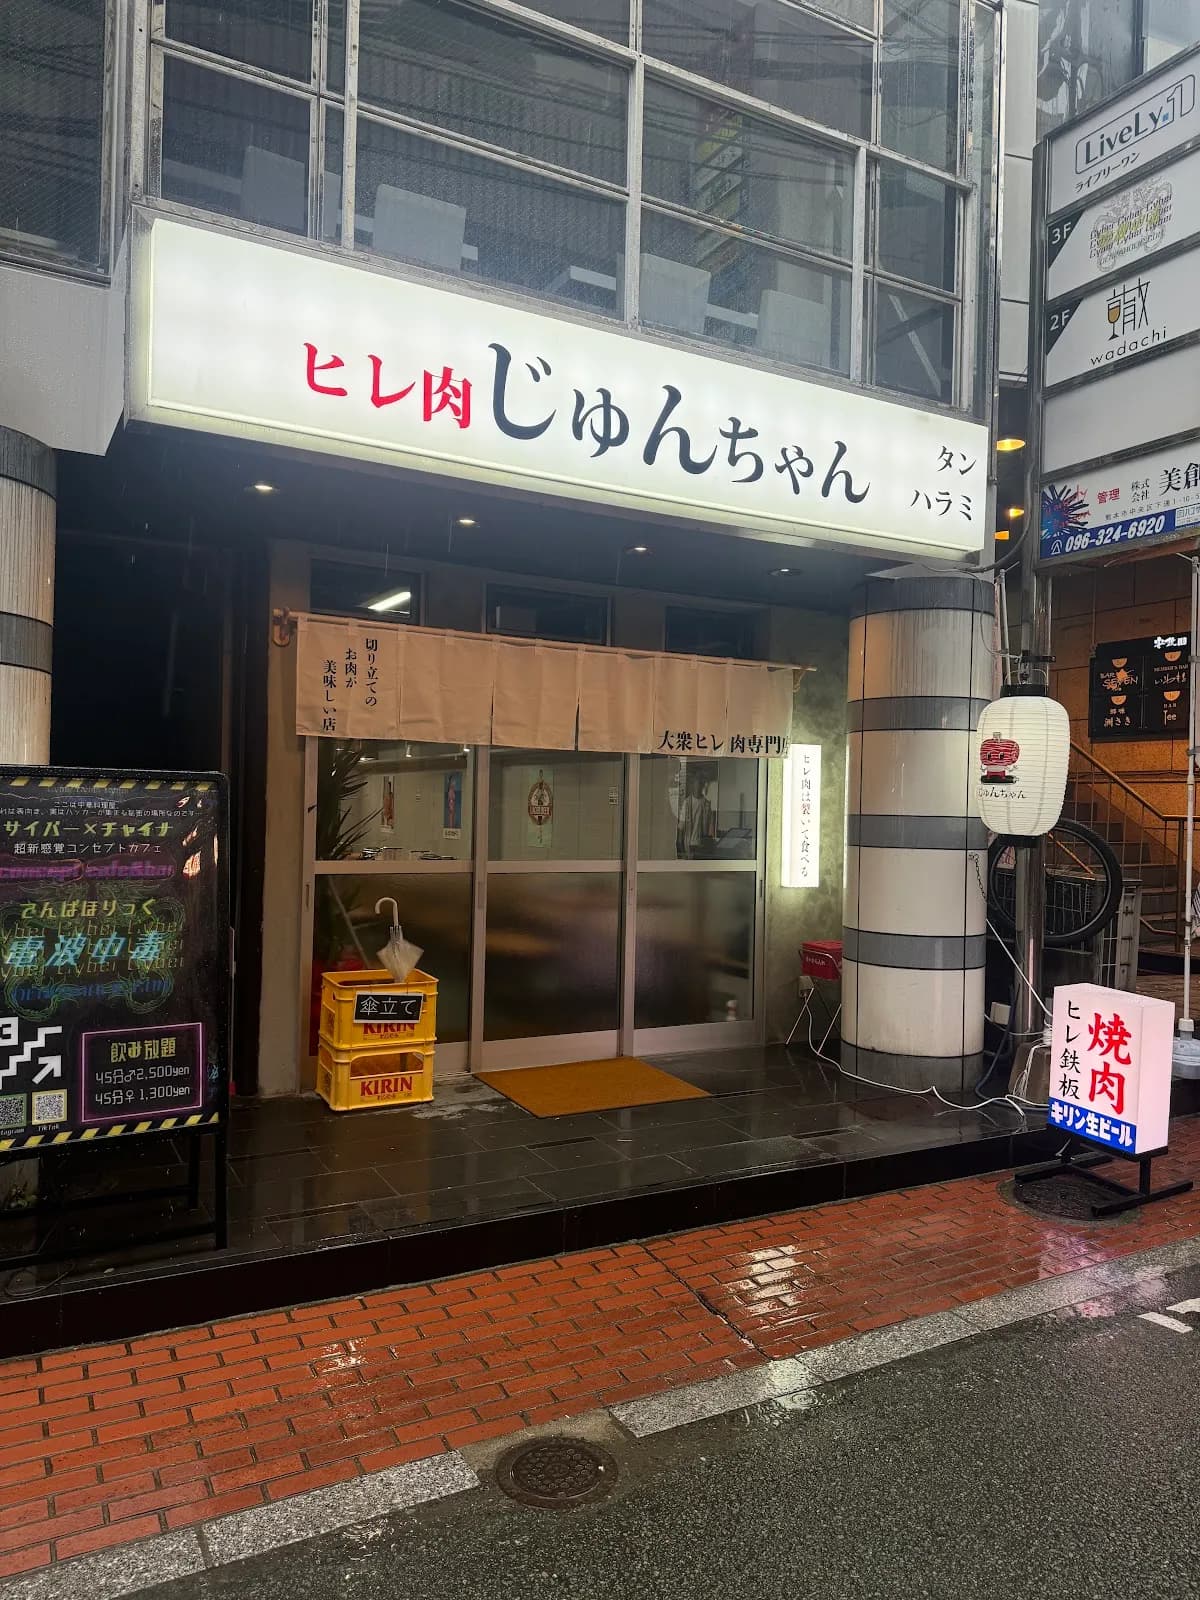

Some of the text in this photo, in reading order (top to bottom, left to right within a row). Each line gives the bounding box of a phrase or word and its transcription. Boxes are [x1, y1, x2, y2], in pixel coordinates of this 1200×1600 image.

[1051, 221, 1071, 245] 3F
[1050, 309, 1071, 331] 2F
[1090, 326, 1167, 366] wadachi
[303, 342, 871, 504] ヒレ肉 じゅんちゃん
[937, 445, 977, 476] タン
[910, 489, 973, 521] ハラミ
[1097, 487, 1120, 505] 管理
[1065, 515, 1166, 552] 096-324-6920
[345, 647, 357, 688] お肉が
[365, 638, 379, 707] 切り立ての
[322, 659, 337, 731] 美味しい店
[14, 842, 161, 854] 超新感覚コンセプトカフェ
[359, 995, 417, 1016] 傘立て
[110, 1037, 177, 1063] 飲み放題
[1059, 1000, 1081, 1100] ヒレ鉄板
[1087, 1012, 1132, 1115] 焼肉
[360, 1076, 413, 1097] KIRIN
[1051, 1100, 1133, 1147] キリン生ビール
